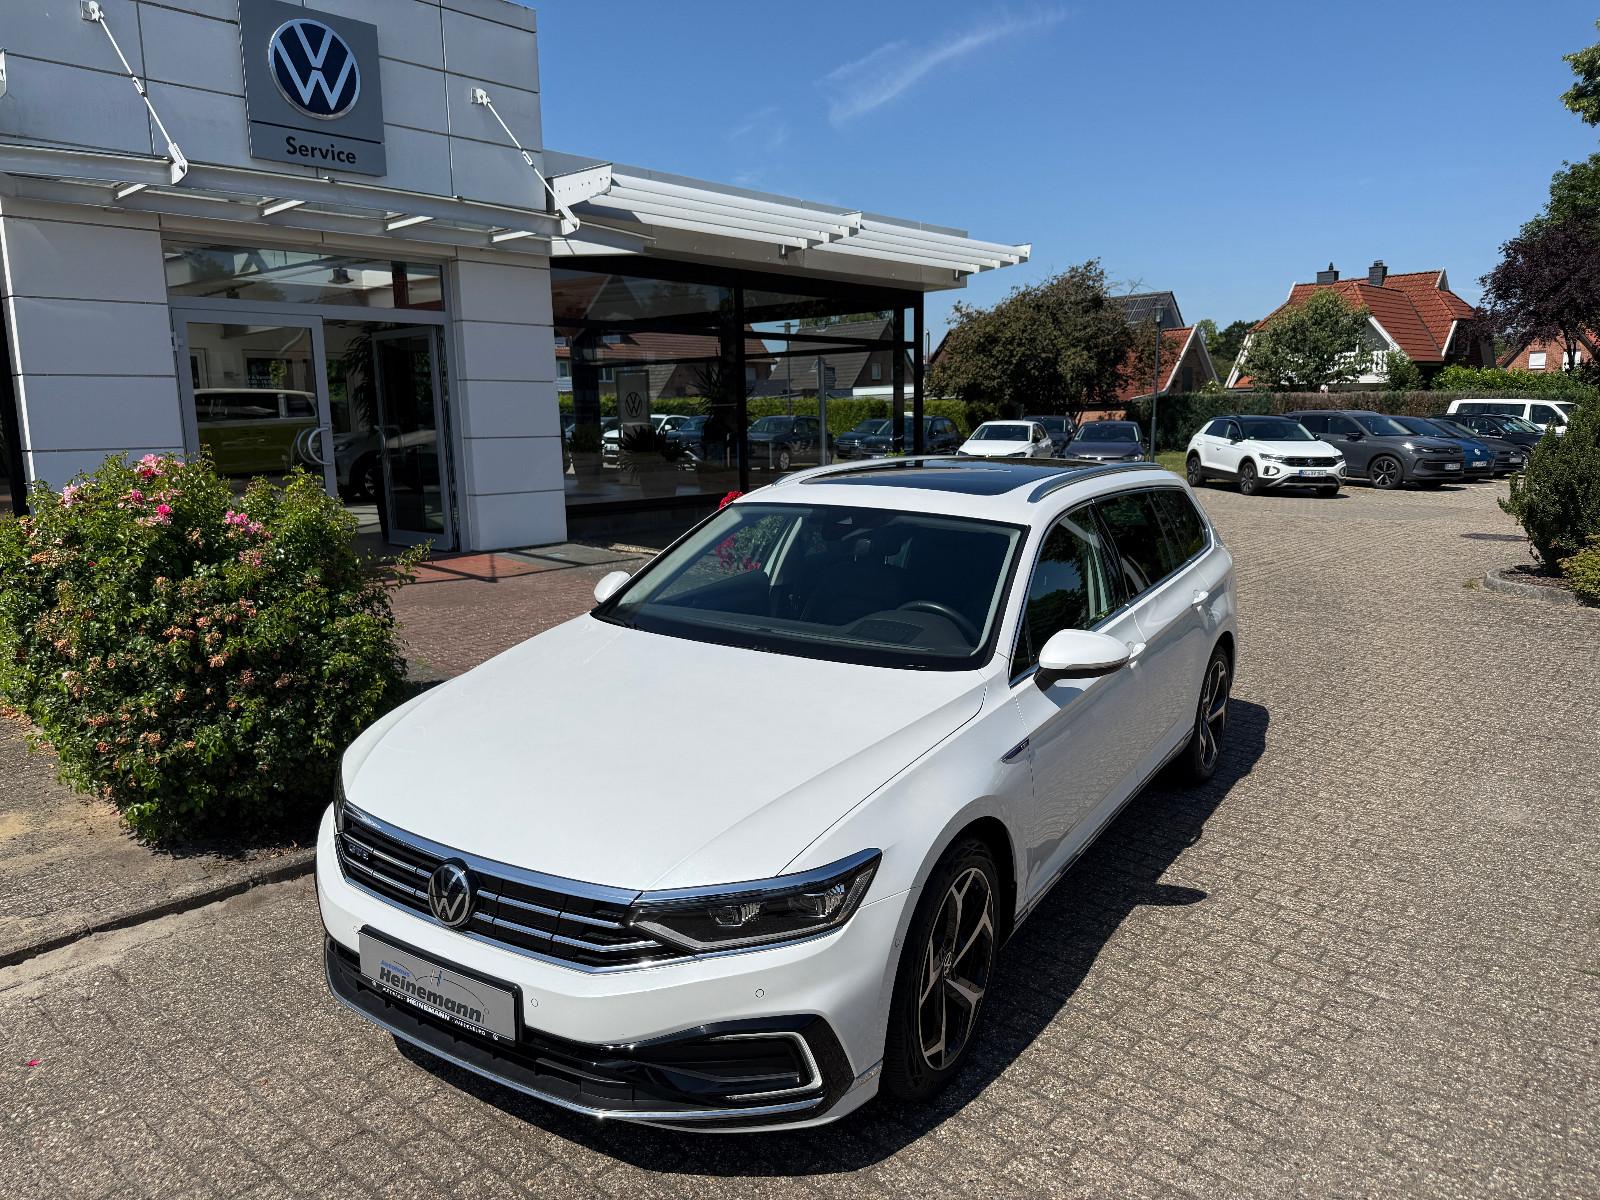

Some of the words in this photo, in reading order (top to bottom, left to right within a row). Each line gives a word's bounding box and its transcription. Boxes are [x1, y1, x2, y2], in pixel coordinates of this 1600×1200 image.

[285, 136, 357, 164] Service
[379, 966, 482, 1023] Heinemann
[406, 997, 450, 1021] HEINEMANN
